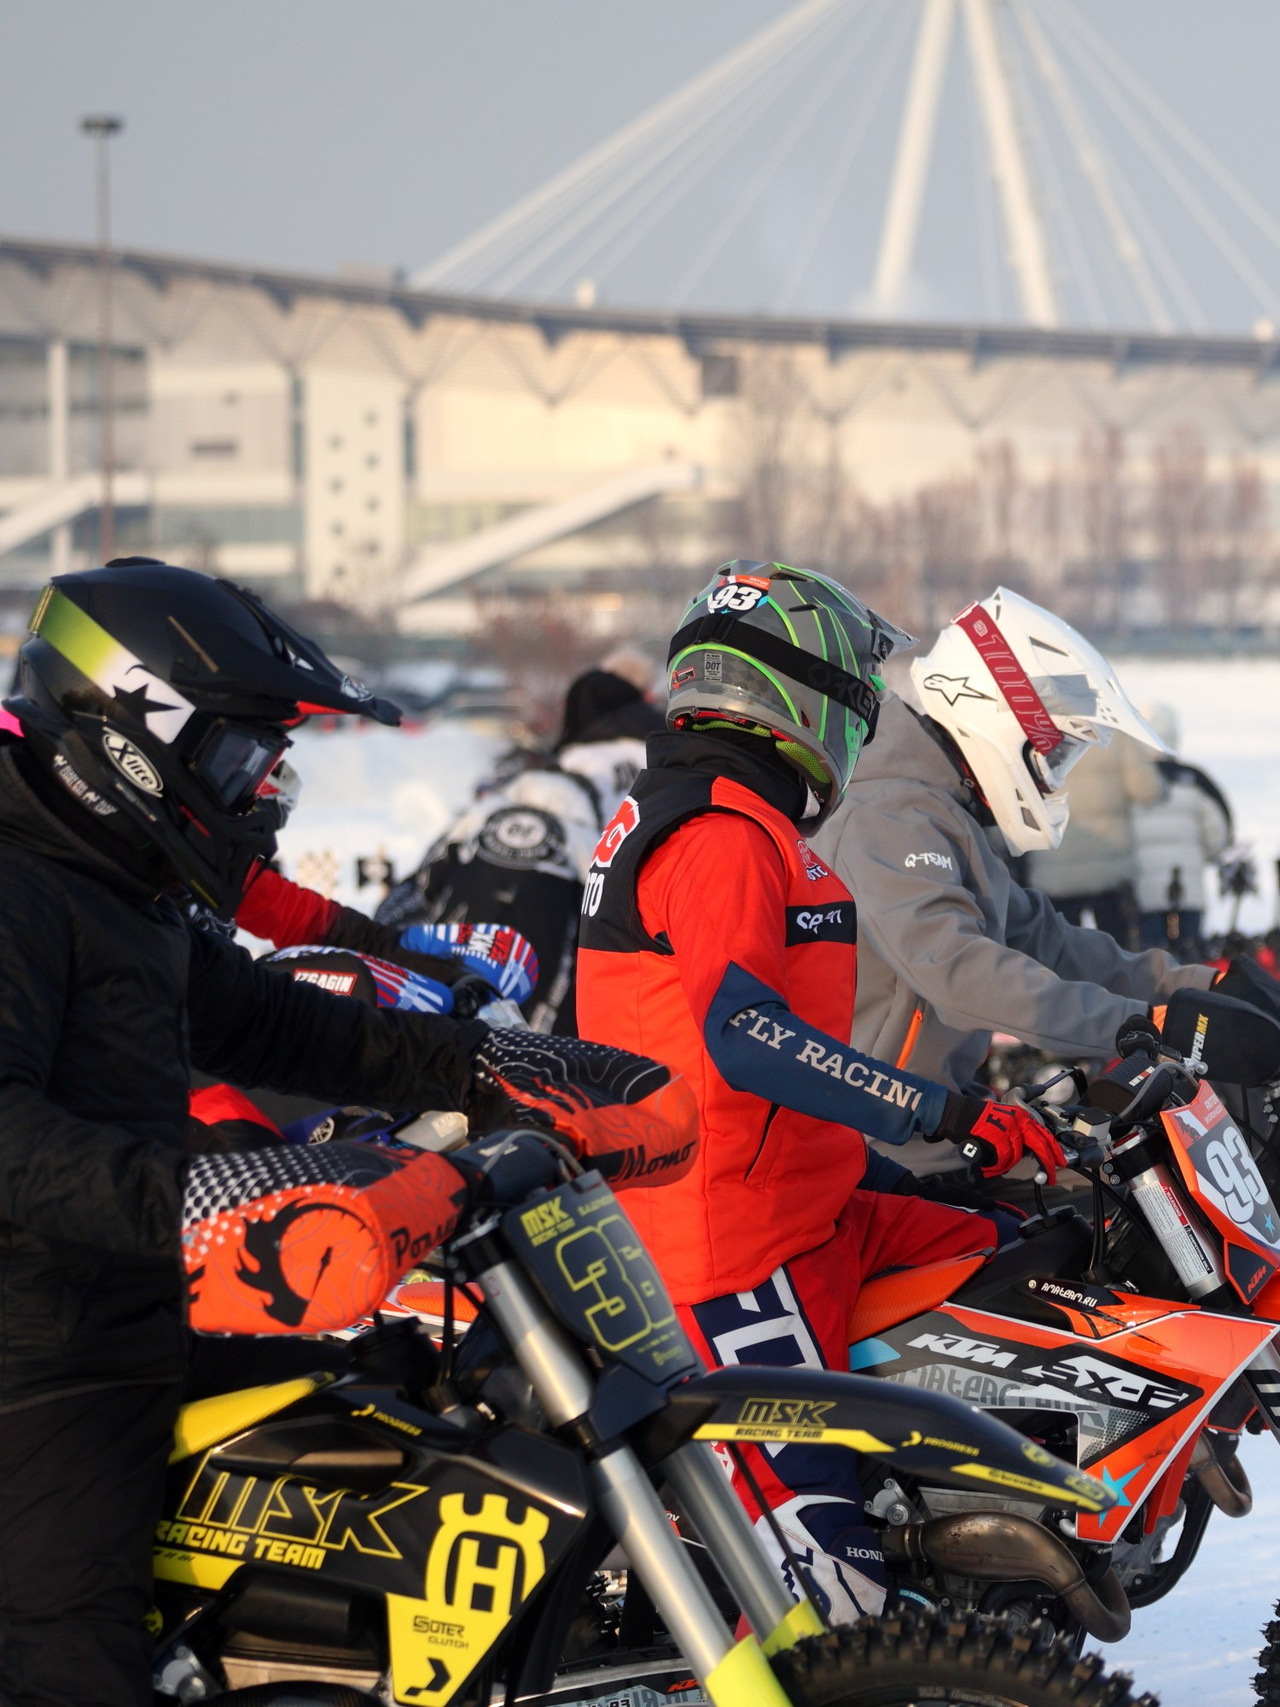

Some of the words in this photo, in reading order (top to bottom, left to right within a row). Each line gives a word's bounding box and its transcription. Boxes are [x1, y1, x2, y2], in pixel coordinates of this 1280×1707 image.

[710, 584, 762, 612] 93
[705, 661, 721, 671] DOT
[107, 740, 155, 787] X-lite
[904, 852, 953, 871] Q-TEAM
[728, 1008, 796, 1050] FLY
[1205, 1126, 1270, 1222] 93
[519, 1196, 571, 1240] MSK
[1166, 1190, 1183, 1218] WARNING
[1247, 1265, 1268, 1294] KTM
[906, 1332, 1019, 1369] KTM
[1048, 1361, 1190, 1409] SX-F
[373, 1411, 423, 1436] PROGRESS
[737, 1397, 837, 1428] MSK
[734, 1427, 782, 1439] RACING
[785, 1428, 825, 1440] TEAM
[923, 1436, 981, 1456] PROGRESS
[175, 1447, 430, 1560] MSK
[155, 1520, 250, 1556] RACING
[253, 1537, 327, 1571] TEAM
[413, 1614, 466, 1638] SUTER
[427, 1635, 470, 1650] CLUTCH
